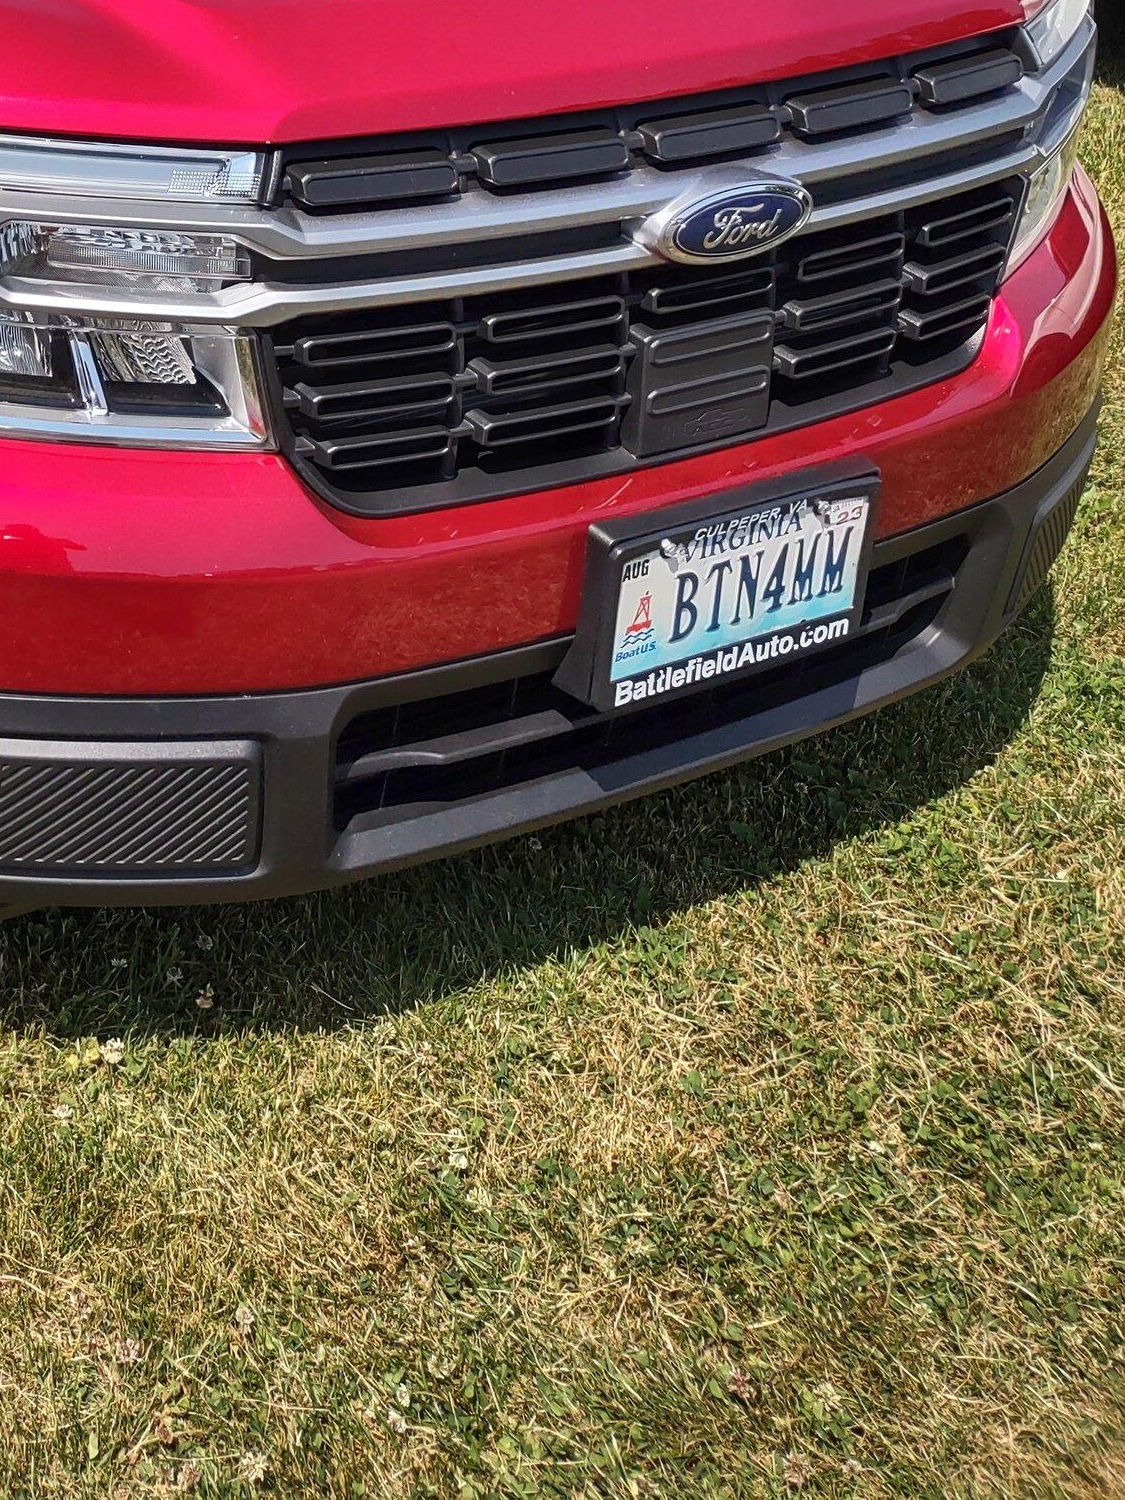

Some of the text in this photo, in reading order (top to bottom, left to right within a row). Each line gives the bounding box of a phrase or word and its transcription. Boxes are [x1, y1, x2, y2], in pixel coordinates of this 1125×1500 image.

[702, 202, 783, 250] Ford
[789, 498, 808, 513] VA
[836, 505, 864, 525] 23
[683, 510, 803, 563] VIRGINIA
[622, 559, 650, 582] AUG
[667, 526, 854, 644] BTN4MM
[614, 618, 849, 707] BattlefieldAuto.com
